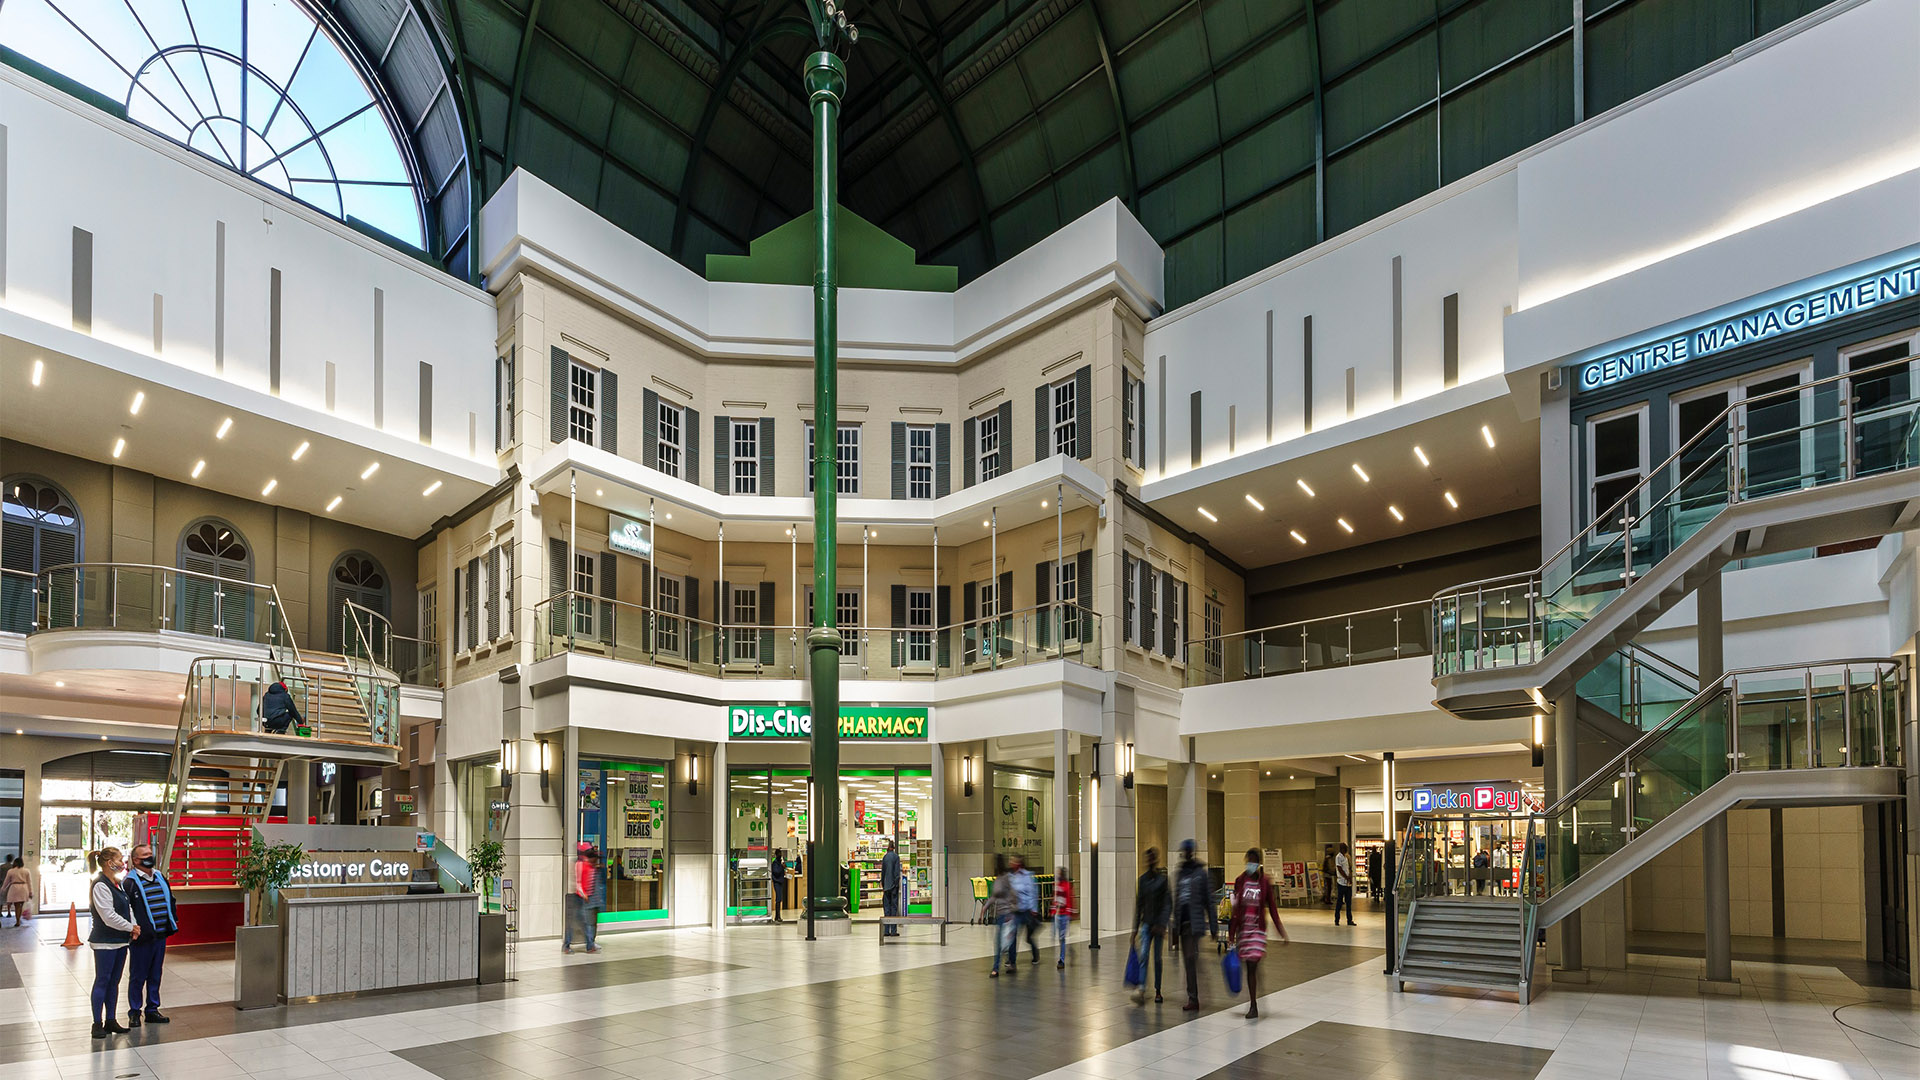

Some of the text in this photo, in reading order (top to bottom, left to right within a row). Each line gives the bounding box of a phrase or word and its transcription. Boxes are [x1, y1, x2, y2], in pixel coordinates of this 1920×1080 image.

[1583, 267, 1920, 386] CENTRE MANAGEMENT
[732, 709, 924, 735] Dis-Che PHARMACY
[629, 783, 648, 794] DEALS
[1414, 786, 1519, 812] Pick n Pay
[628, 812, 650, 821] DISCOUNT
[627, 824, 650, 836] DEALS
[370, 859, 409, 876] Care
[629, 859, 648, 870] DEALS
